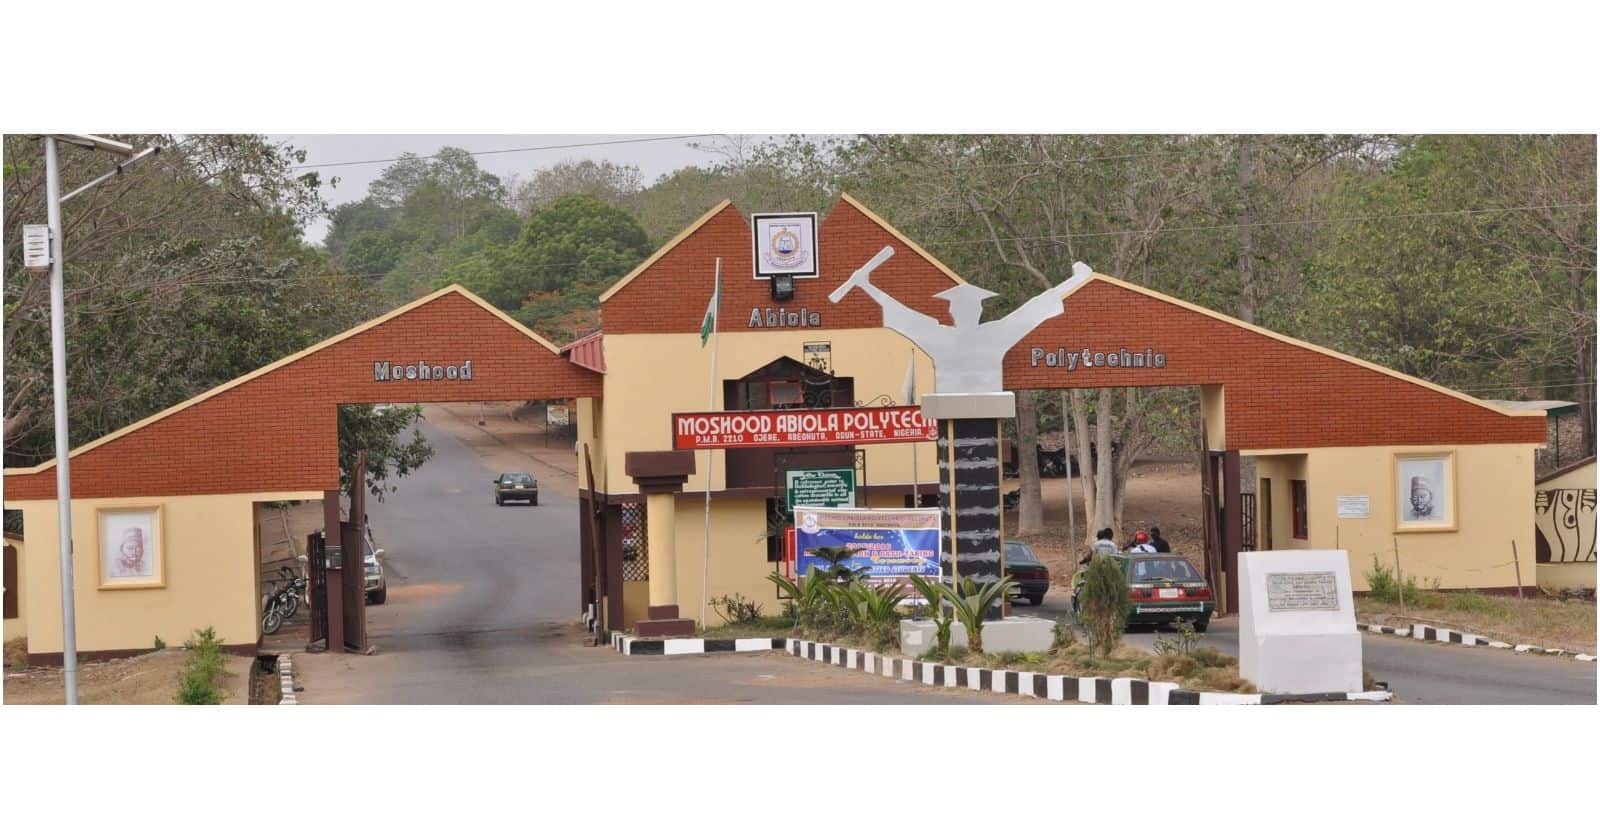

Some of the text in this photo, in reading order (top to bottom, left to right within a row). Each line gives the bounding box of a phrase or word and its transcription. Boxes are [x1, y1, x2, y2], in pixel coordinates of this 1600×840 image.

[748, 307, 821, 328] Abiola
[1031, 347, 1167, 372] Polytechnic
[374, 360, 472, 381] Moshood
[678, 415, 771, 435] MOSHOOD
[777, 413, 838, 433] ABIOLA
[723, 434, 744, 443] 2210
